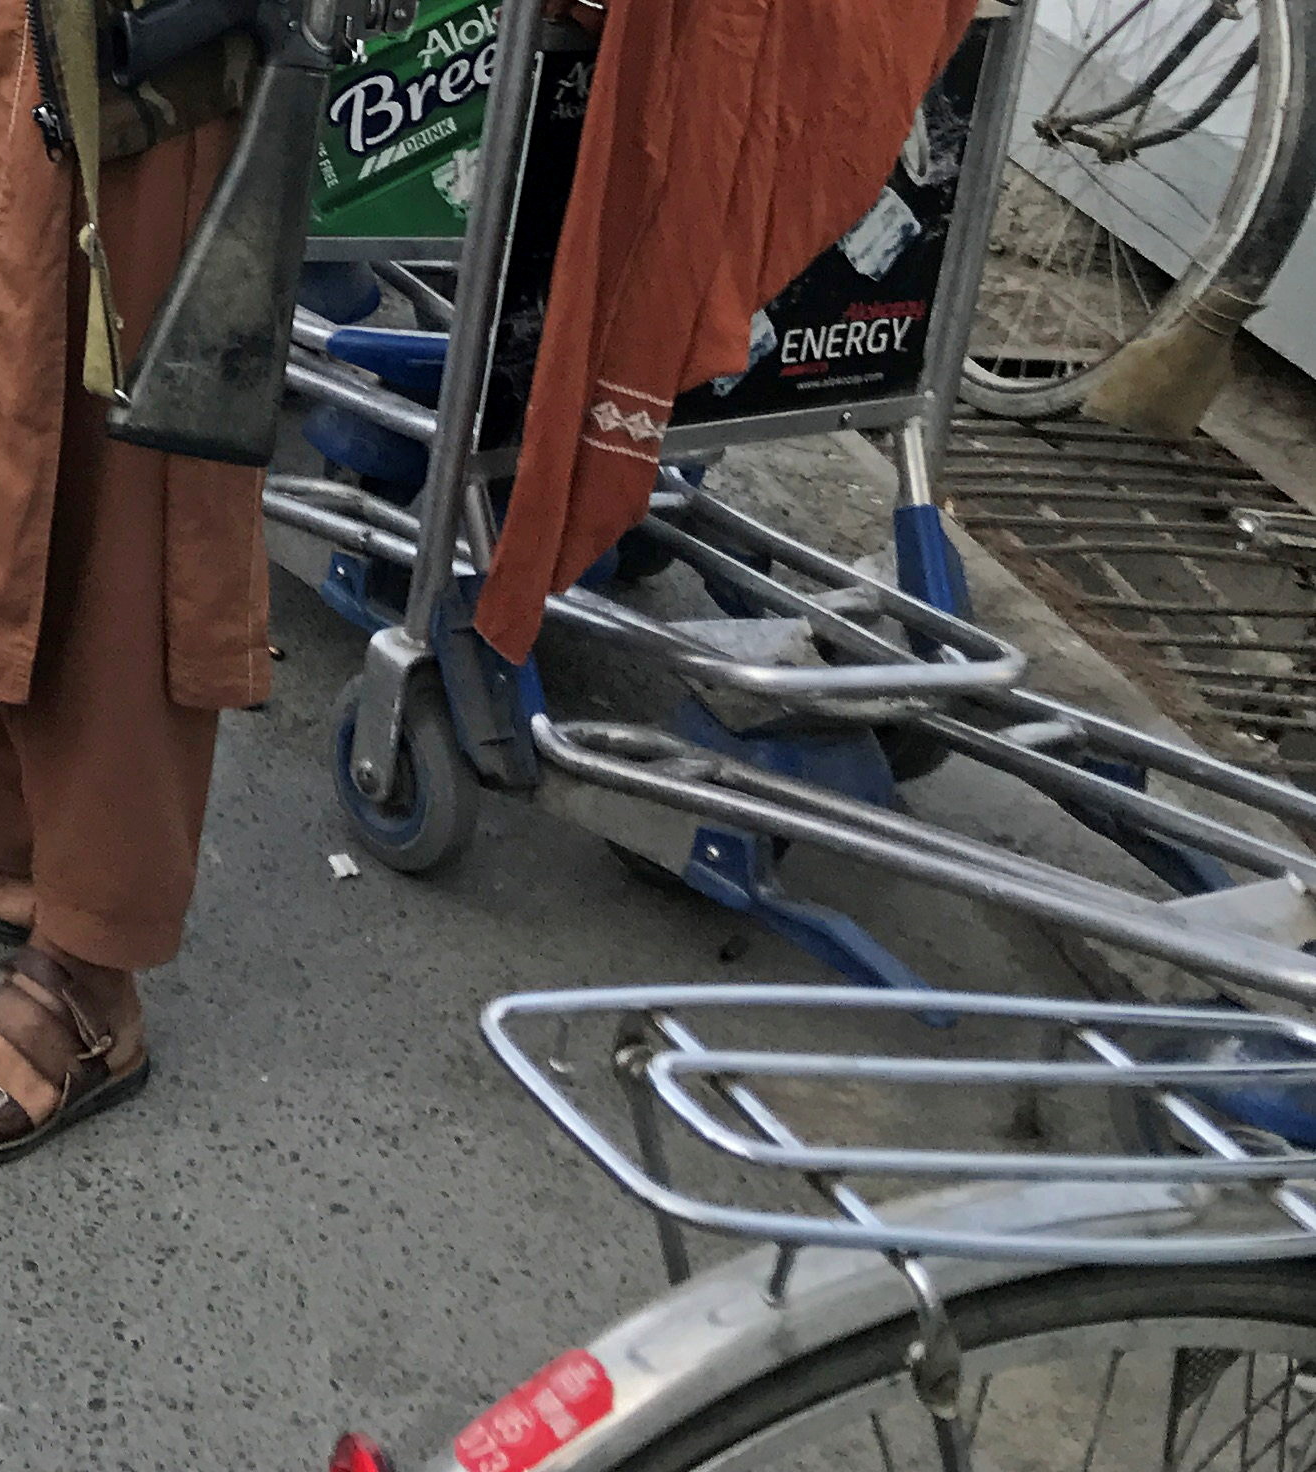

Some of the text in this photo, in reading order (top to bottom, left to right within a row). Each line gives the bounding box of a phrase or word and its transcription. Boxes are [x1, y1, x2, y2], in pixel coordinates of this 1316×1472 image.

[329, 40, 499, 153] Bree
[404, 116, 458, 154] DRINK
[781, 316, 913, 364] ENERGY
